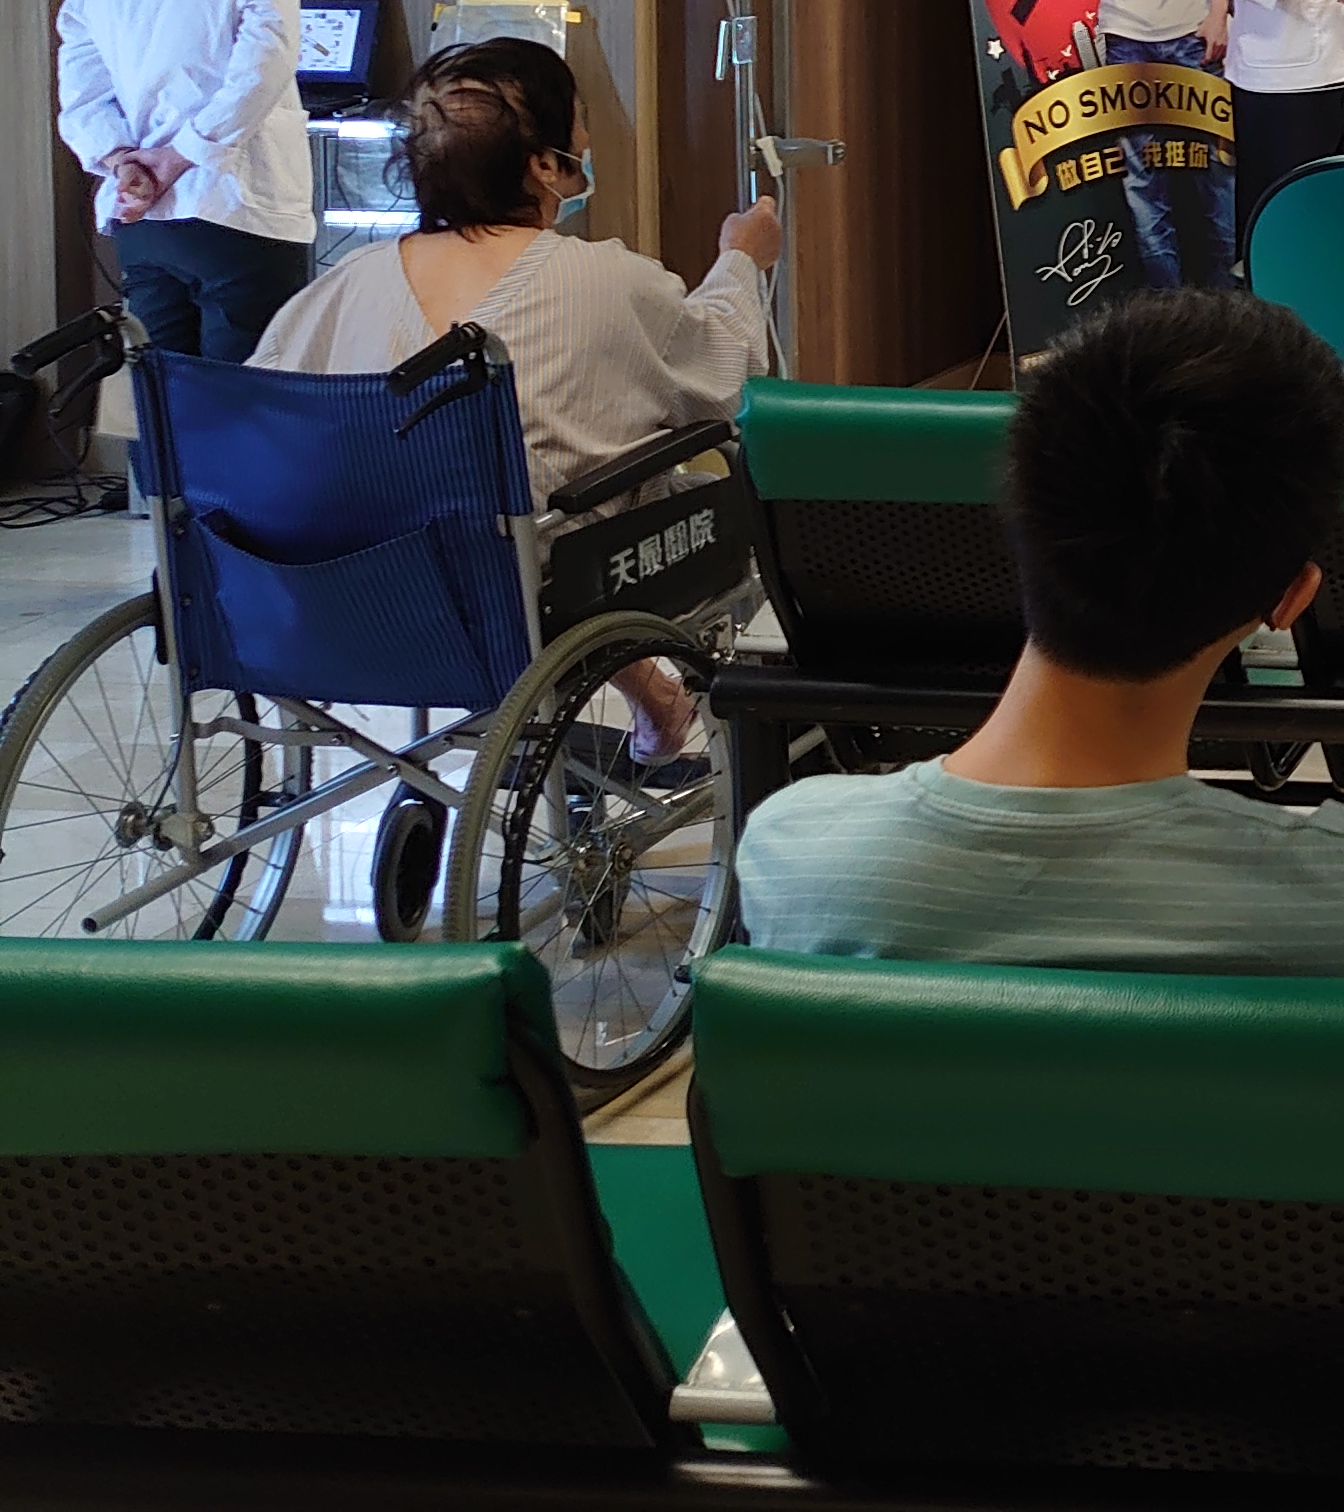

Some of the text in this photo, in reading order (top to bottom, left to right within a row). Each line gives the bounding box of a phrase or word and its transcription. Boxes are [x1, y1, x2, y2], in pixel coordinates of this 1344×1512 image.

[1022, 79, 1233, 144] NO SMOKING
[1055, 140, 1209, 191] 做自己 我挺你
[609, 508, 717, 595] 天晟醫院
